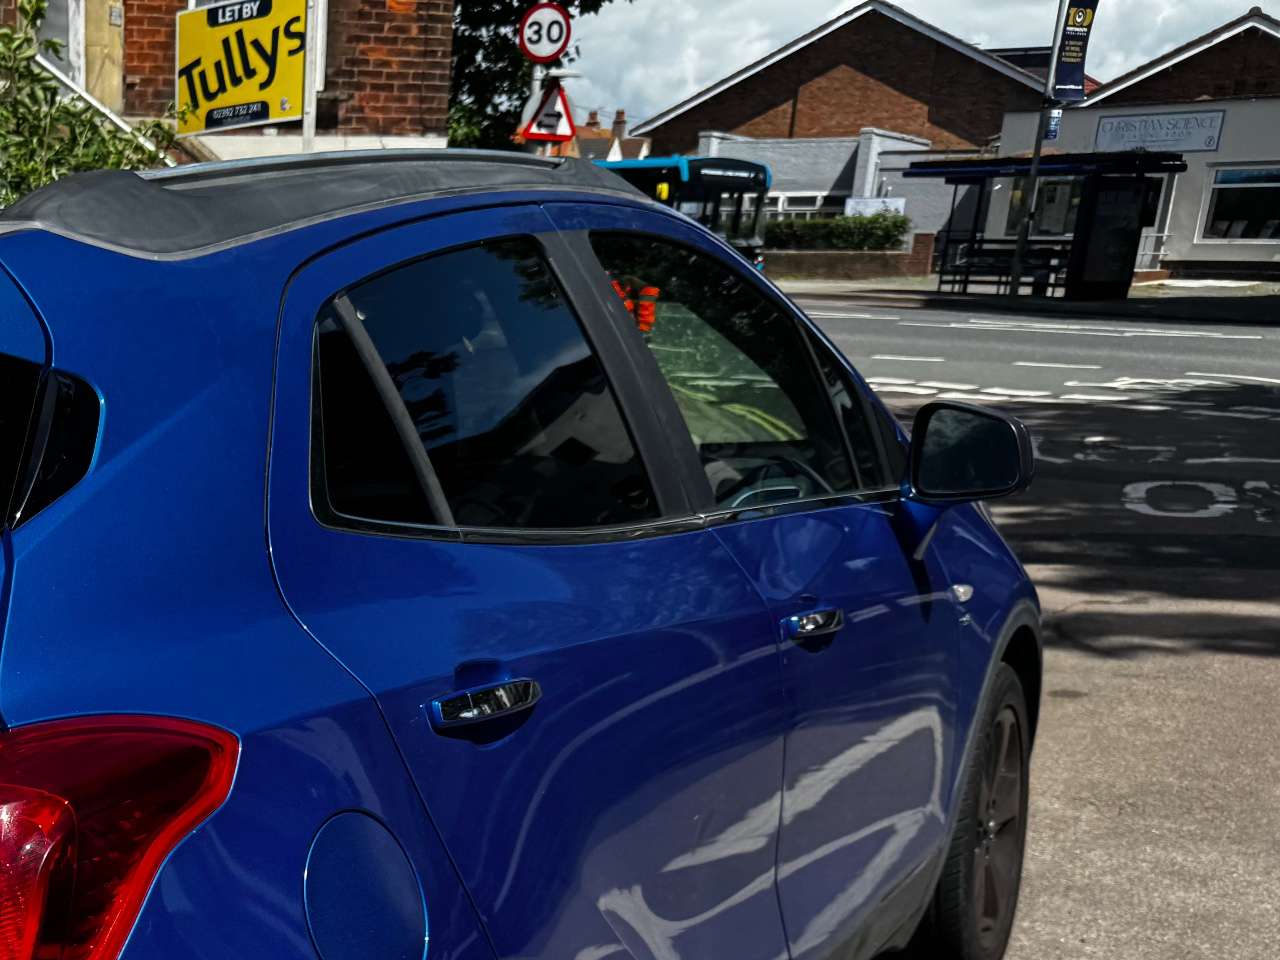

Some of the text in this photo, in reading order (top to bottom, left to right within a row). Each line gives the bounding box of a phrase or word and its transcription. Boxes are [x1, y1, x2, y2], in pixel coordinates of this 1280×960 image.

[218, 1, 260, 24] LET BY
[527, 20, 564, 45] 30
[178, 15, 306, 110] Tullys
